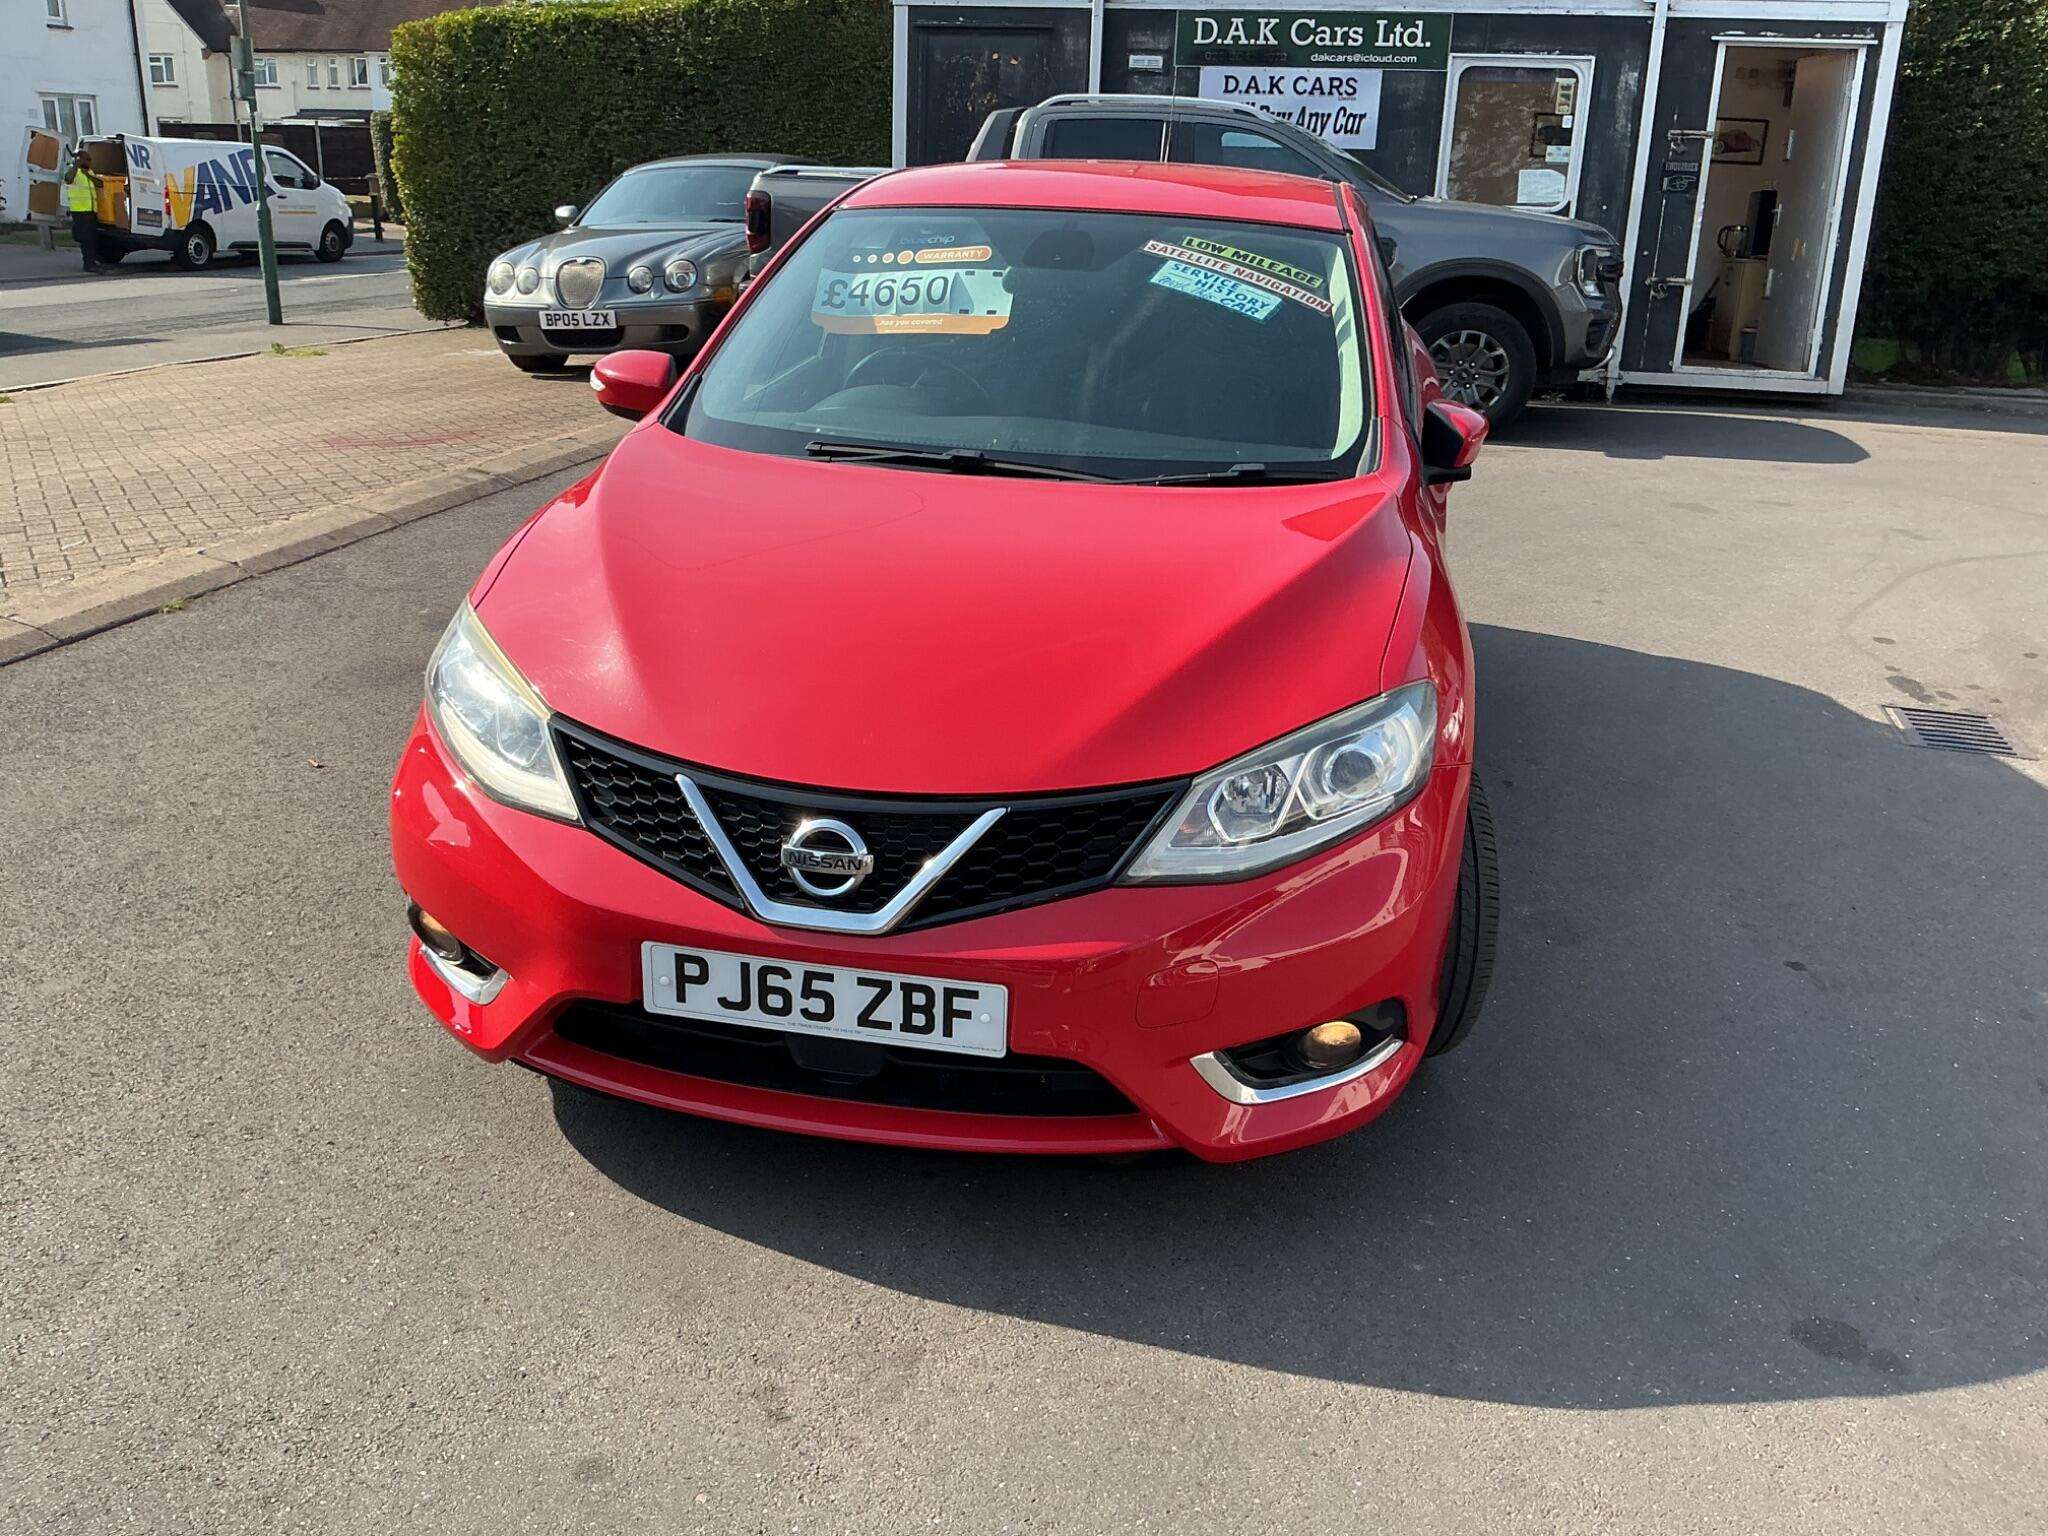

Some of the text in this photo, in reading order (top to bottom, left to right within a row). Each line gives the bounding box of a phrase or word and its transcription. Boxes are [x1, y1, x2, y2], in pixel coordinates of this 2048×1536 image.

[1194, 17, 1432, 48] D.A.K Cars Ltd.
[1310, 53, 1417, 64] dakcars@icloud.com
[1222, 74, 1358, 97] D.A.K CARS
[1296, 105, 1333, 137] Any
[1333, 105, 1367, 136] Car
[923, 249, 984, 260] WARRANTY
[1186, 237, 1322, 288] LOW MILEAGE
[1148, 243, 1329, 311] SATELLITE NAVIGATION
[1173, 262, 1240, 291] SERVICE
[821, 275, 949, 310] £4650
[1194, 279, 1271, 310] HISTORY
[1219, 297, 1262, 316] CAR
[545, 312, 610, 327] BP05 LZX
[788, 851, 863, 871] NISSAN
[674, 953, 980, 1038] PJ65 ZBF
